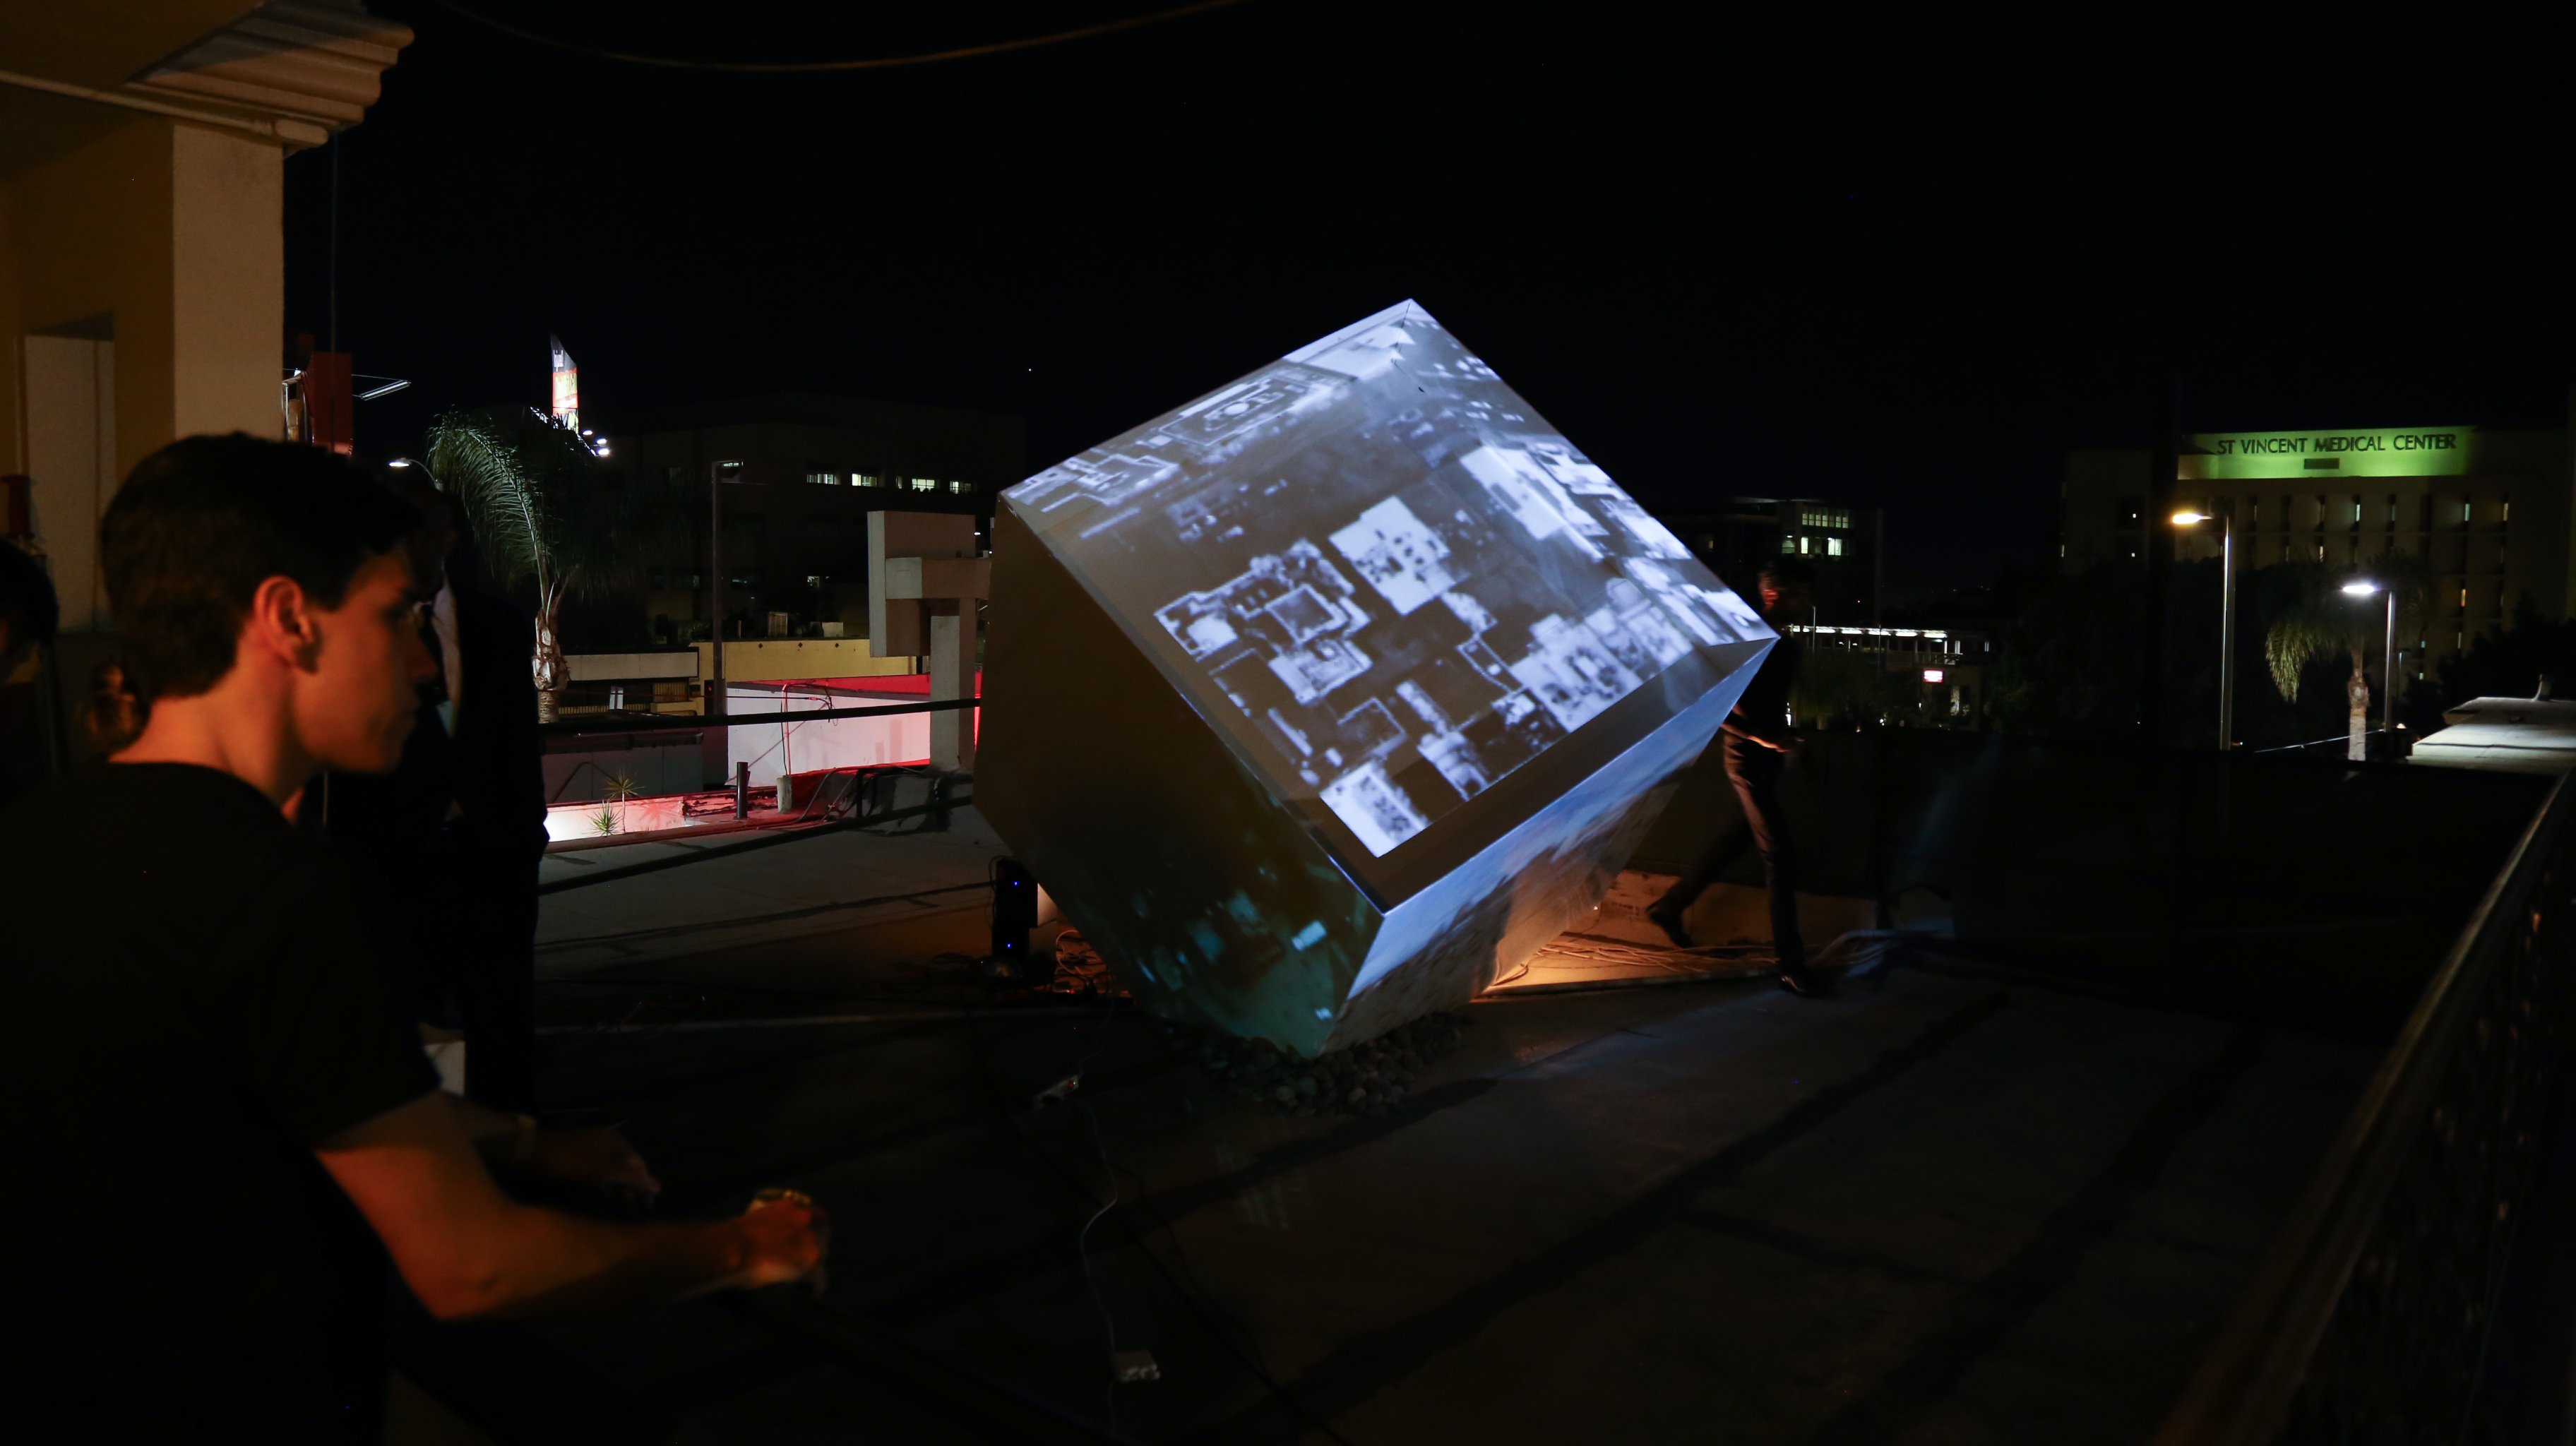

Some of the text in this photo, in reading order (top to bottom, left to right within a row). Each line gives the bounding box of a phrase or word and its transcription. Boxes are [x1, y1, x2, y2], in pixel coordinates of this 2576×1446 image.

[2217, 434, 2457, 455] ST VINCENT MEDICAL CENTER
